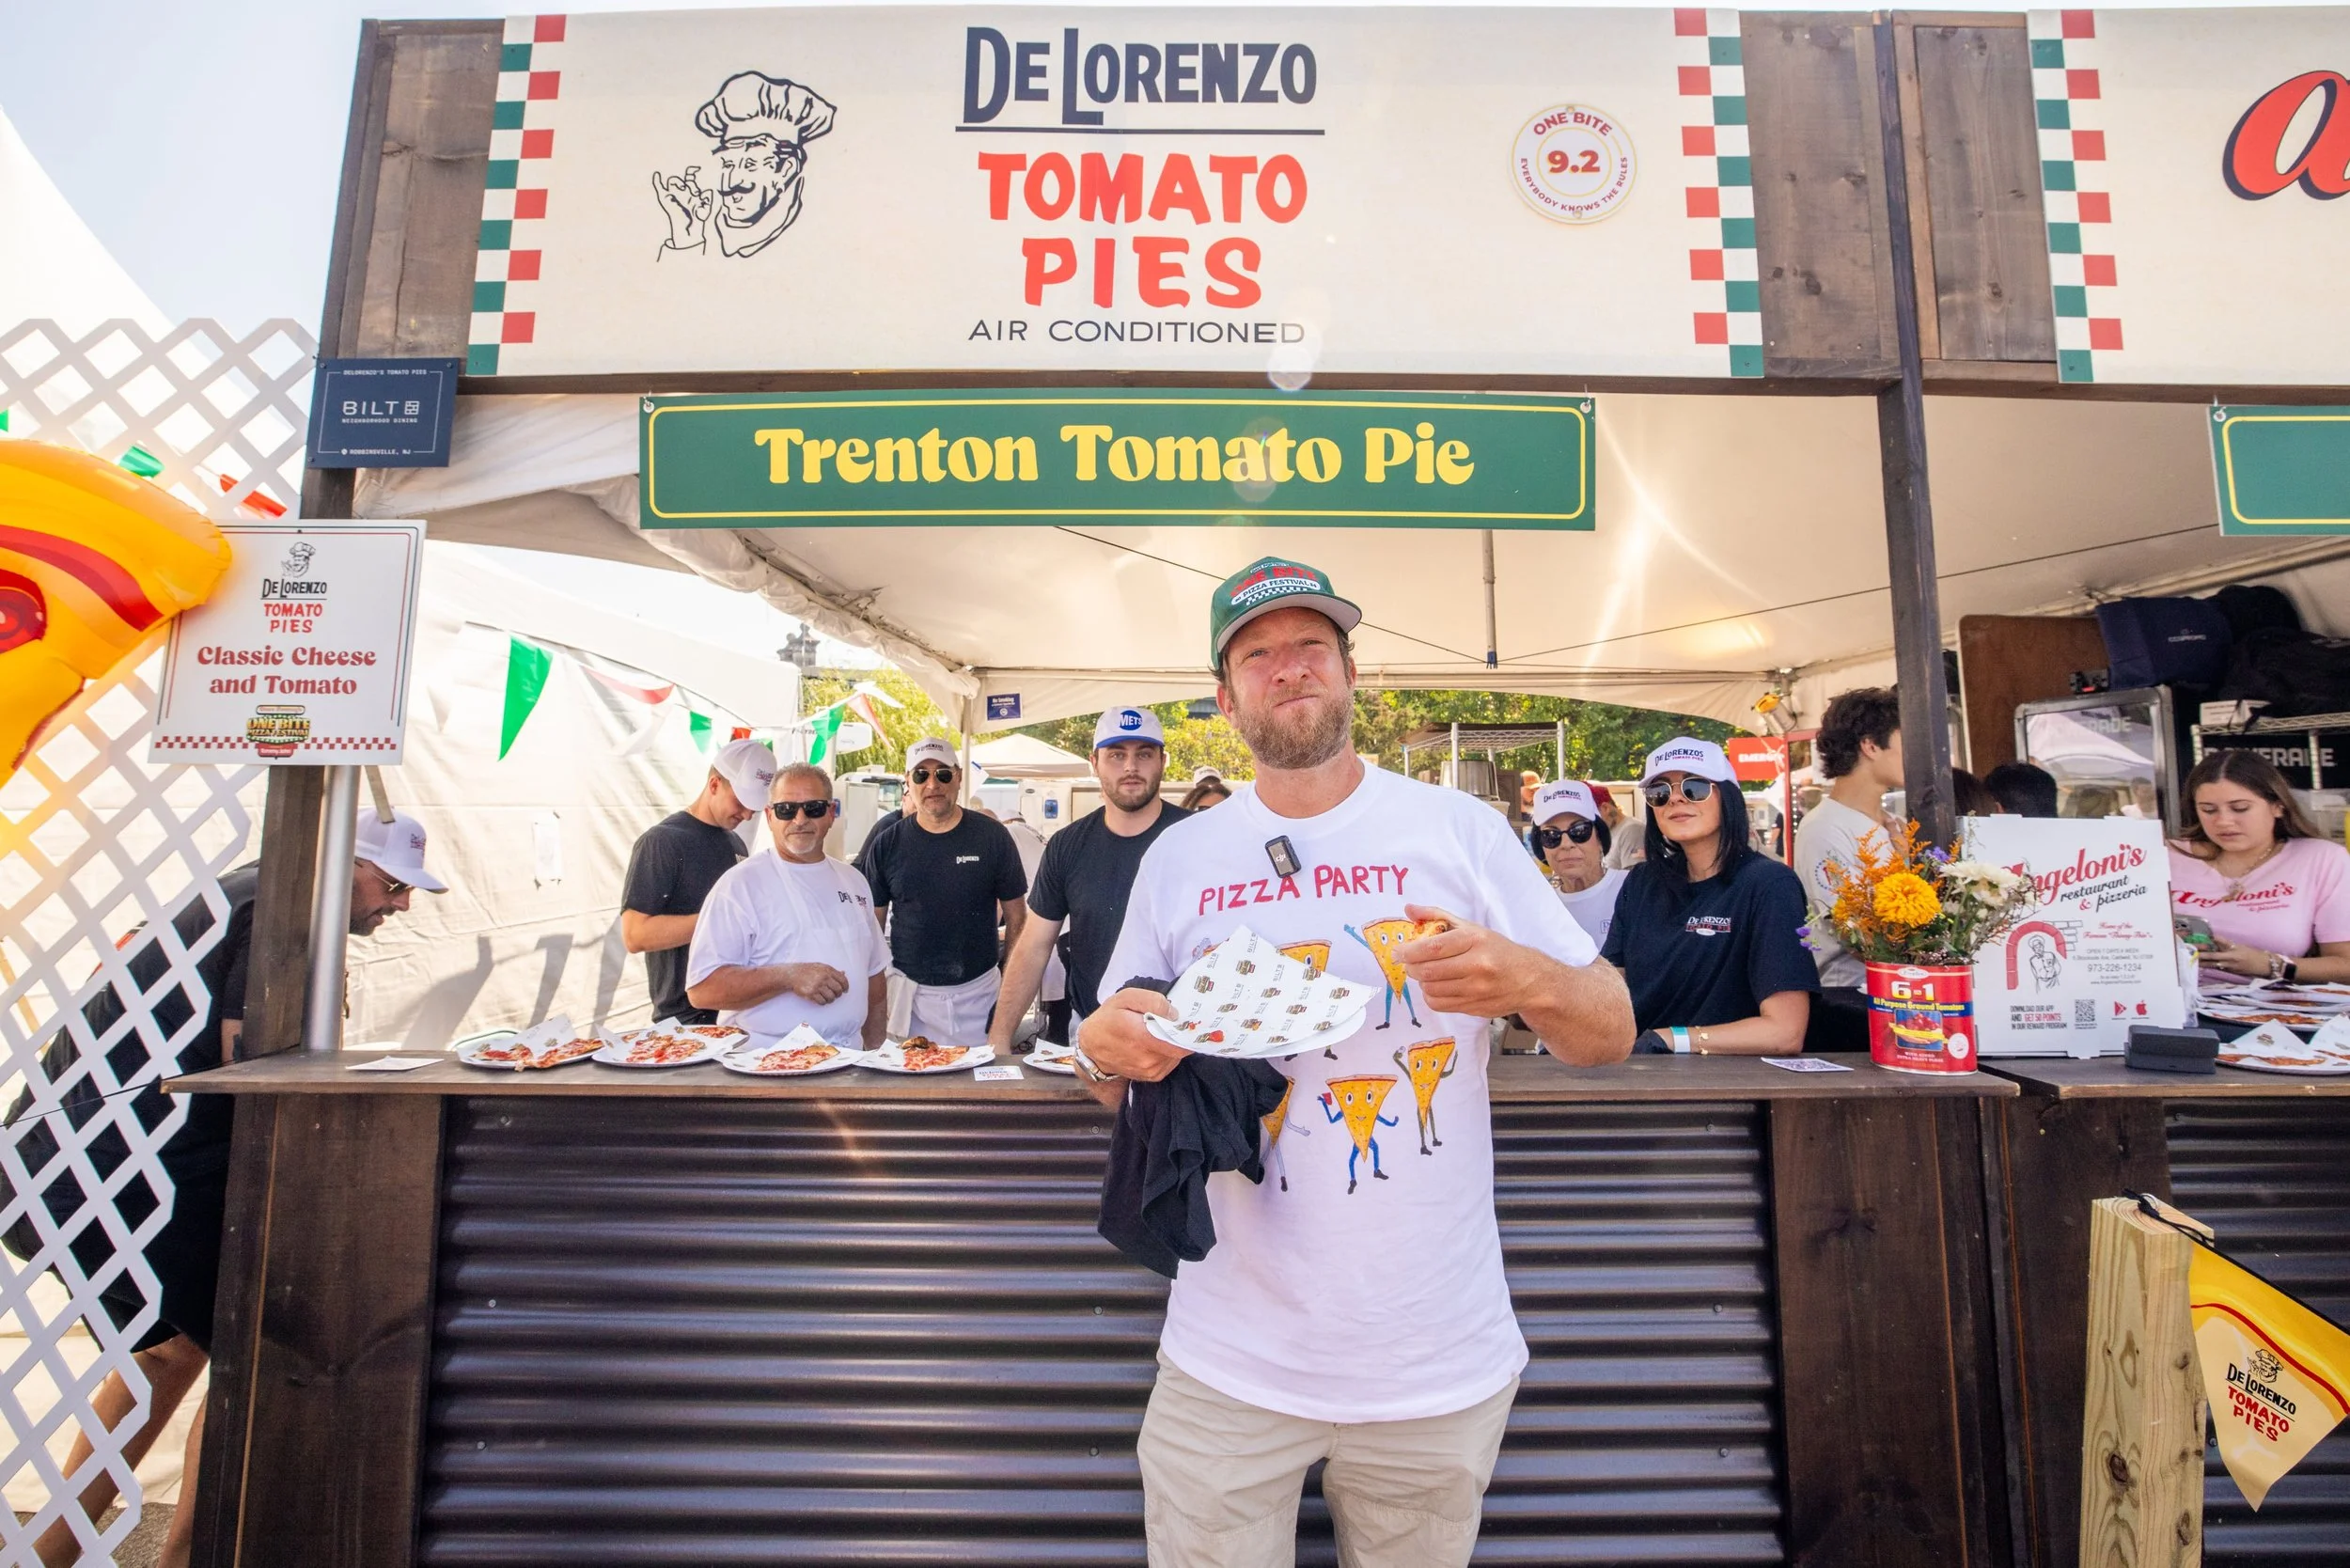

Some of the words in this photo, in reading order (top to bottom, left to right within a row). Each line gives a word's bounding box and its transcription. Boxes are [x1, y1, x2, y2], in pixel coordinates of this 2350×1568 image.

[1533, 112, 1568, 135] ONE
[1573, 112, 1612, 136] BITE
[1547, 149, 1601, 174] 9.2
[978, 151, 1308, 226] TOMATO
[1520, 158, 1559, 208] EVERYBODY
[1560, 201, 1601, 212] KNOWS
[1601, 189, 1619, 204] THE
[1616, 157, 1627, 187] RULES
[1022, 236, 1261, 309] PIES
[968, 320, 1028, 341] AIR
[1048, 320, 1306, 343] CONDITIONED
[342, 400, 400, 415] BILT
[754, 428, 1039, 484] Trenton
[1059, 425, 1342, 483] Tomato
[1365, 422, 1475, 485] Pie
[1243, 583, 1268, 598] PIZZA
[263, 603, 323, 618] TOMATO
[270, 619, 313, 634] PIES
[197, 645, 284, 666] Classic
[291, 647, 377, 666] Cheese
[210, 675, 257, 694] and
[264, 675, 357, 695] Tomato
[247, 719, 275, 729] ONE
[279, 718, 310, 729] BITE
[1120, 714, 1143, 727] METS
[1198, 874, 1301, 916] PIZZA
[1313, 864, 1409, 899] PARTY
[2060, 875, 2129, 902] restaurant
[2078, 899, 2092, 911] &
[2096, 884, 2147, 913] pizzeria
[2087, 964, 2142, 972] 973-226-1234
[1881, 998, 1907, 1009] Purpose
[1907, 1001, 1935, 1011] Ground
[2011, 1013, 2022, 1022] AND
[2024, 1013, 2034, 1022] GET
[2043, 1012, 2061, 1022] POINTS
[2228, 1385, 2290, 1434] TOMATO
[2232, 1404, 2279, 1442] PIES
